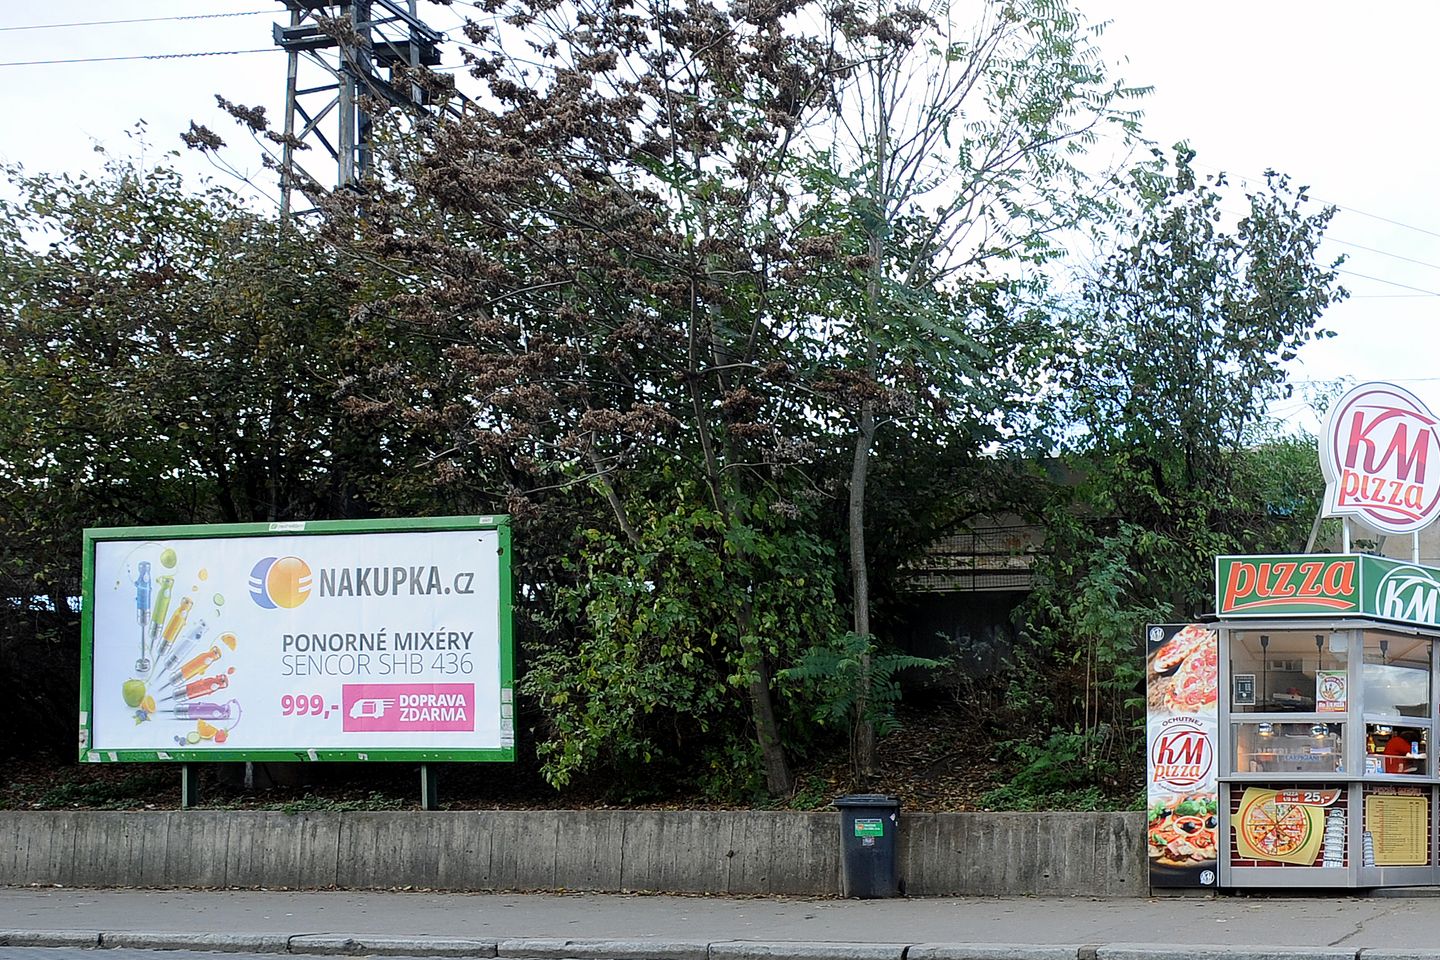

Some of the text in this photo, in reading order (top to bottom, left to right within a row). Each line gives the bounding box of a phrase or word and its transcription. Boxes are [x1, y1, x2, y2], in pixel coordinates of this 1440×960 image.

[1344, 405, 1437, 484] KM
[1338, 469, 1424, 513] pizza
[1222, 560, 1356, 613] pizza
[283, 627, 474, 652] PONORNÉ MIXÉRY
[281, 652, 474, 676] SENCOR SHB 436
[280, 694, 339, 720] 999,-
[399, 694, 466, 707] DOPRAVA
[399, 708, 467, 721] ZDARMA
[1162, 716, 1203, 728] OCHUTNEJ
[1157, 730, 1209, 765] KM
[1153, 764, 1202, 783] pizza
[1304, 792, 1330, 804] 25,-
